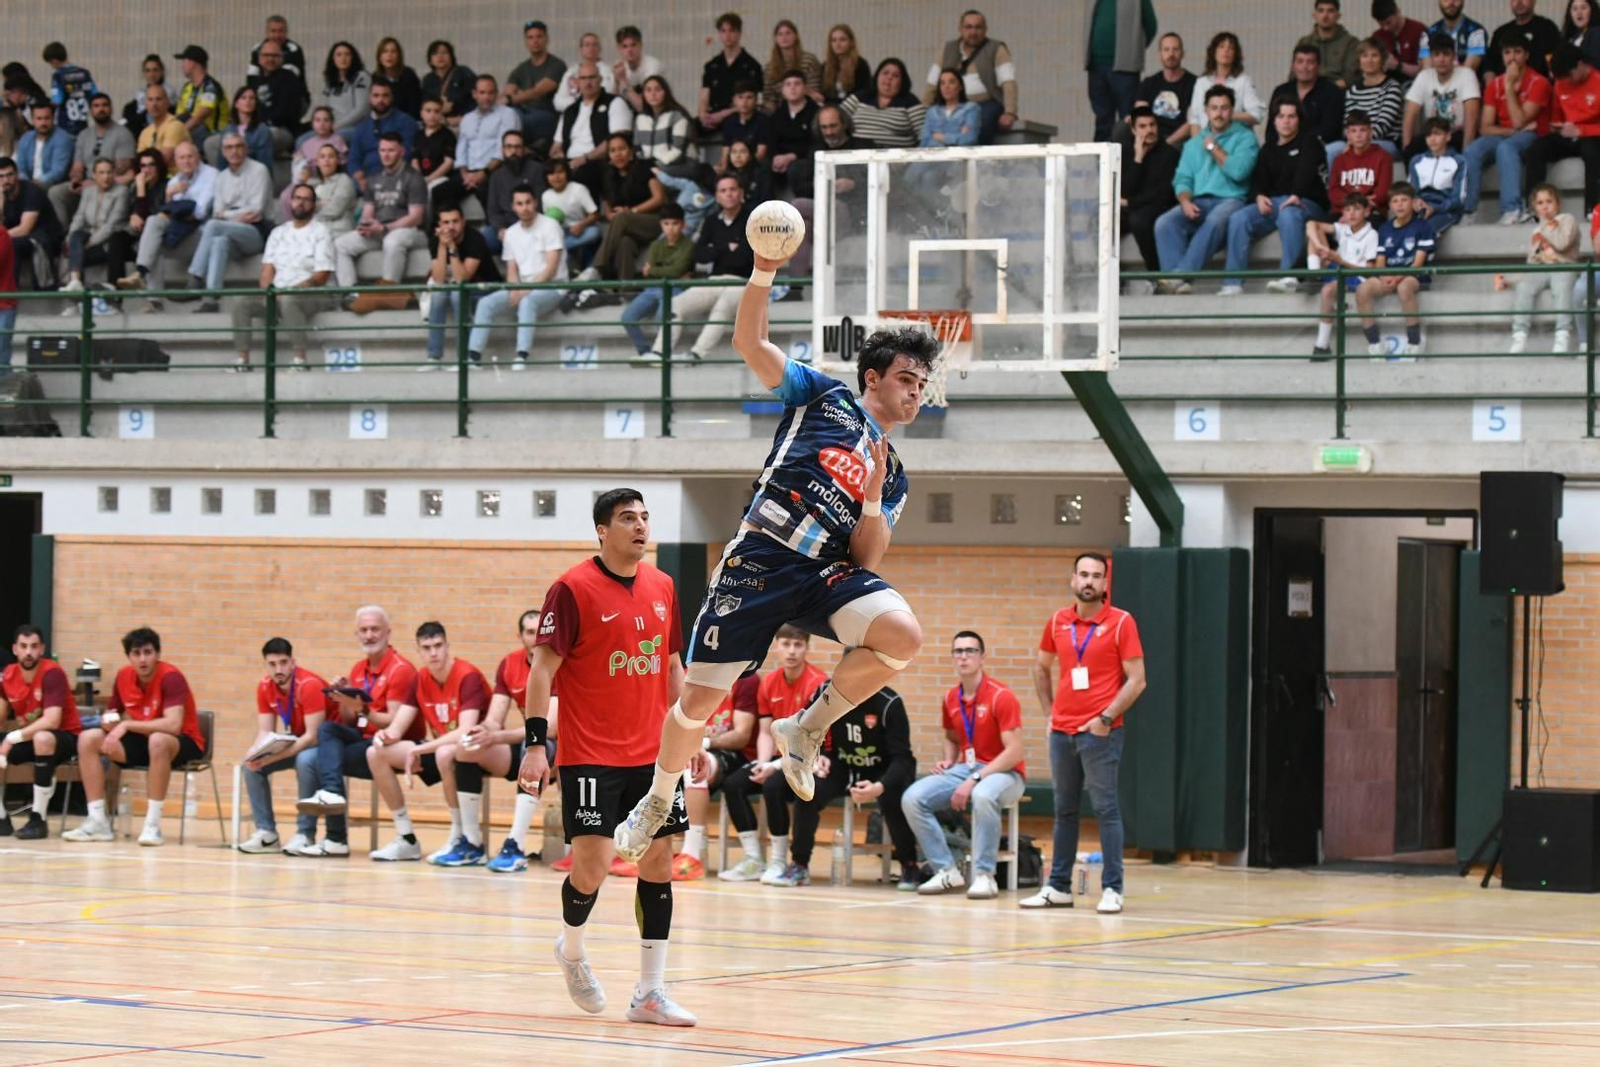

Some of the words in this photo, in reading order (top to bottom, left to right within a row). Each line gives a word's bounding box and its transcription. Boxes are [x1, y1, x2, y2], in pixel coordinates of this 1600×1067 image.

[1340, 168, 1375, 187] PUMA
[328, 347, 358, 371] 28
[564, 346, 595, 368] 27
[129, 409, 143, 432] 9
[361, 408, 376, 431] 8
[616, 408, 632, 432] 7
[821, 402, 863, 431] Fundación
[824, 411, 856, 432] Unicaja
[1189, 407, 1206, 433] 6
[1488, 405, 1507, 432] 5
[634, 616, 645, 631] 11
[703, 625, 720, 650] 4
[845, 722, 863, 744] 16
[577, 777, 597, 807] 11
